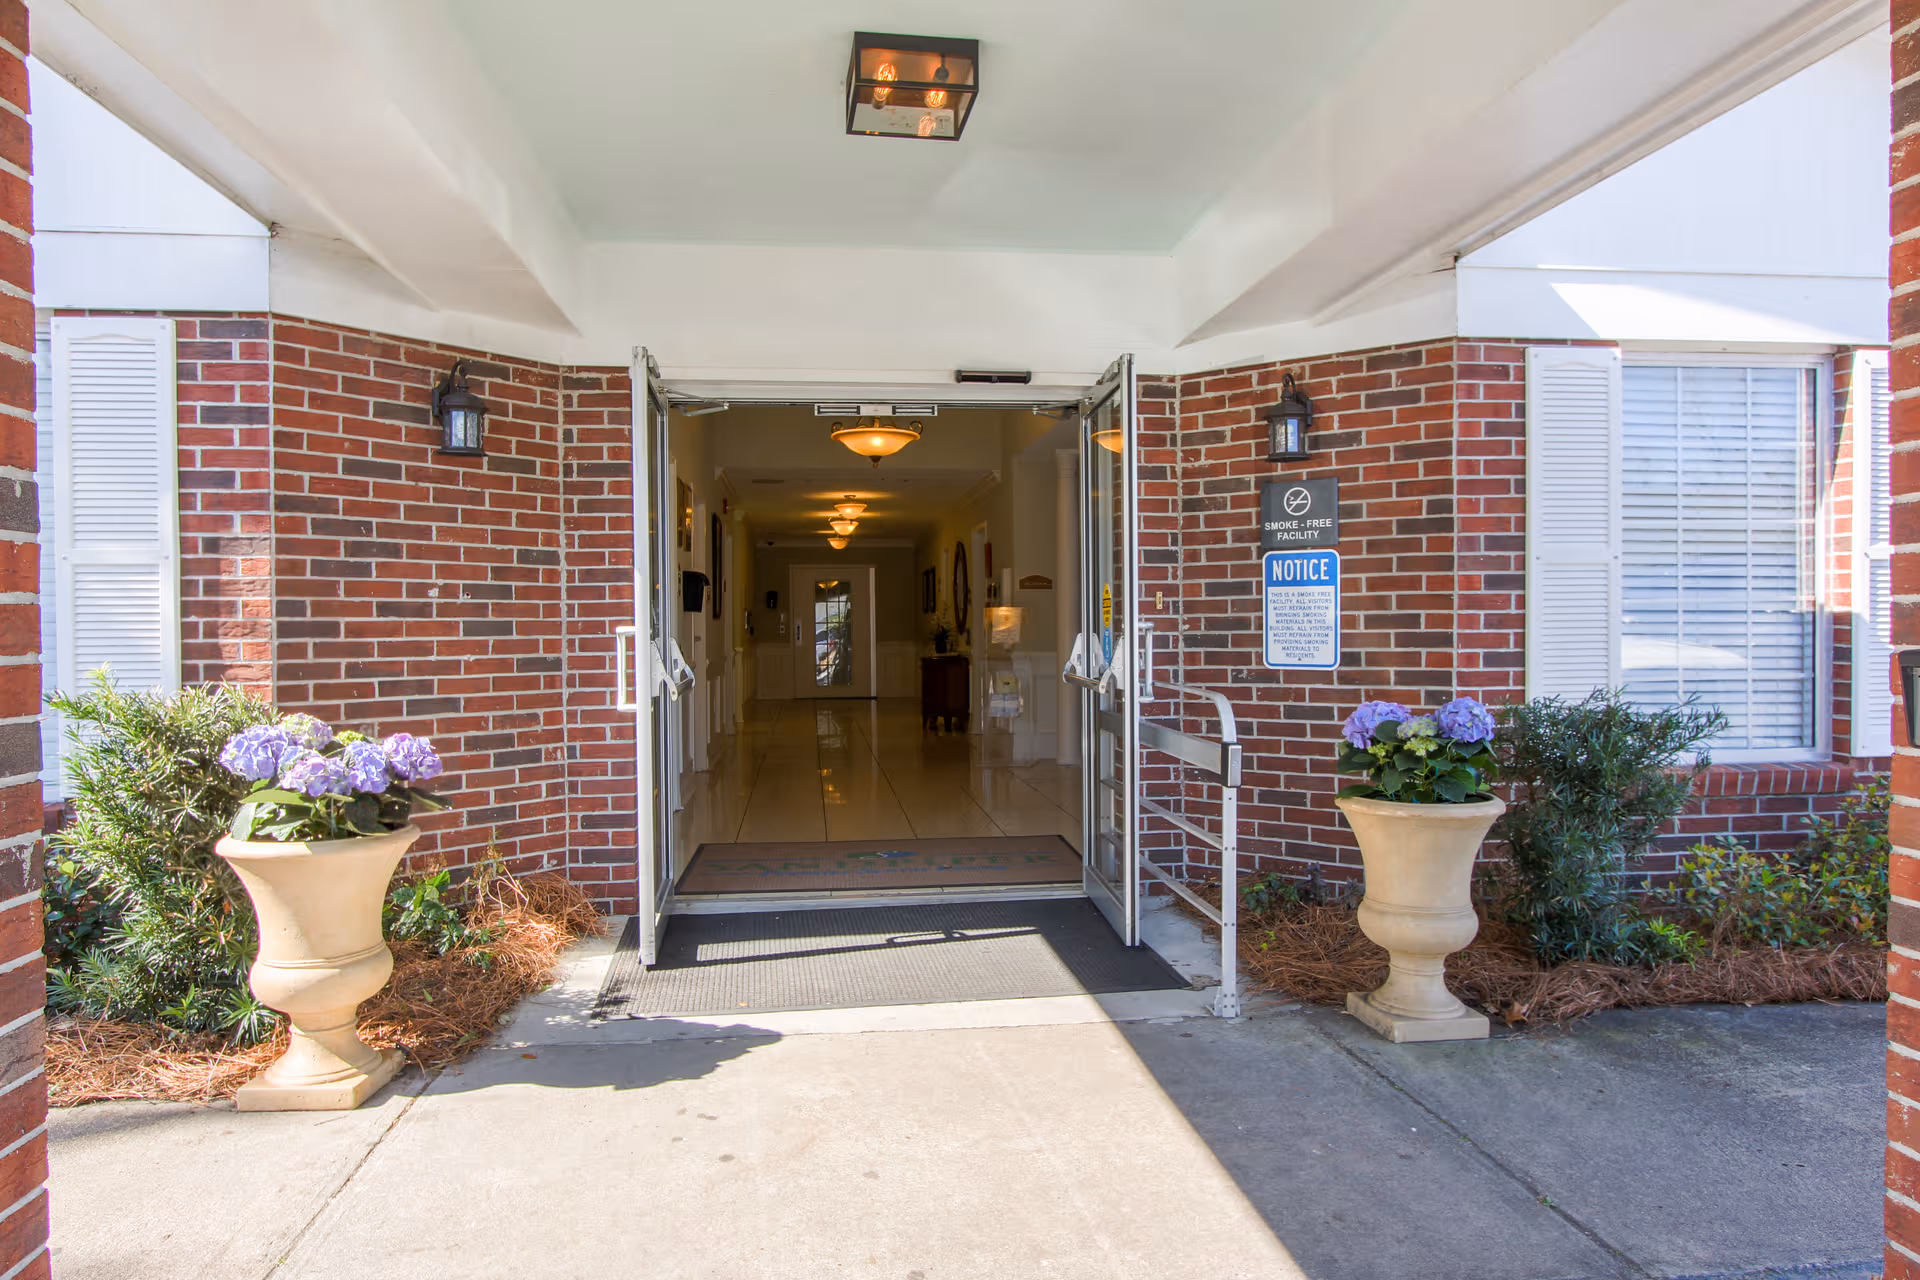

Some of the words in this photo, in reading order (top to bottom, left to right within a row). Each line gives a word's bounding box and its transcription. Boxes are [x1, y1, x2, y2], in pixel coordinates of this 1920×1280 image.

[1264, 521, 1298, 531] SMOKE
[1306, 519, 1332, 528] FREE
[1277, 530, 1319, 540] FACILITY
[1272, 558, 1329, 581] NOTICE
